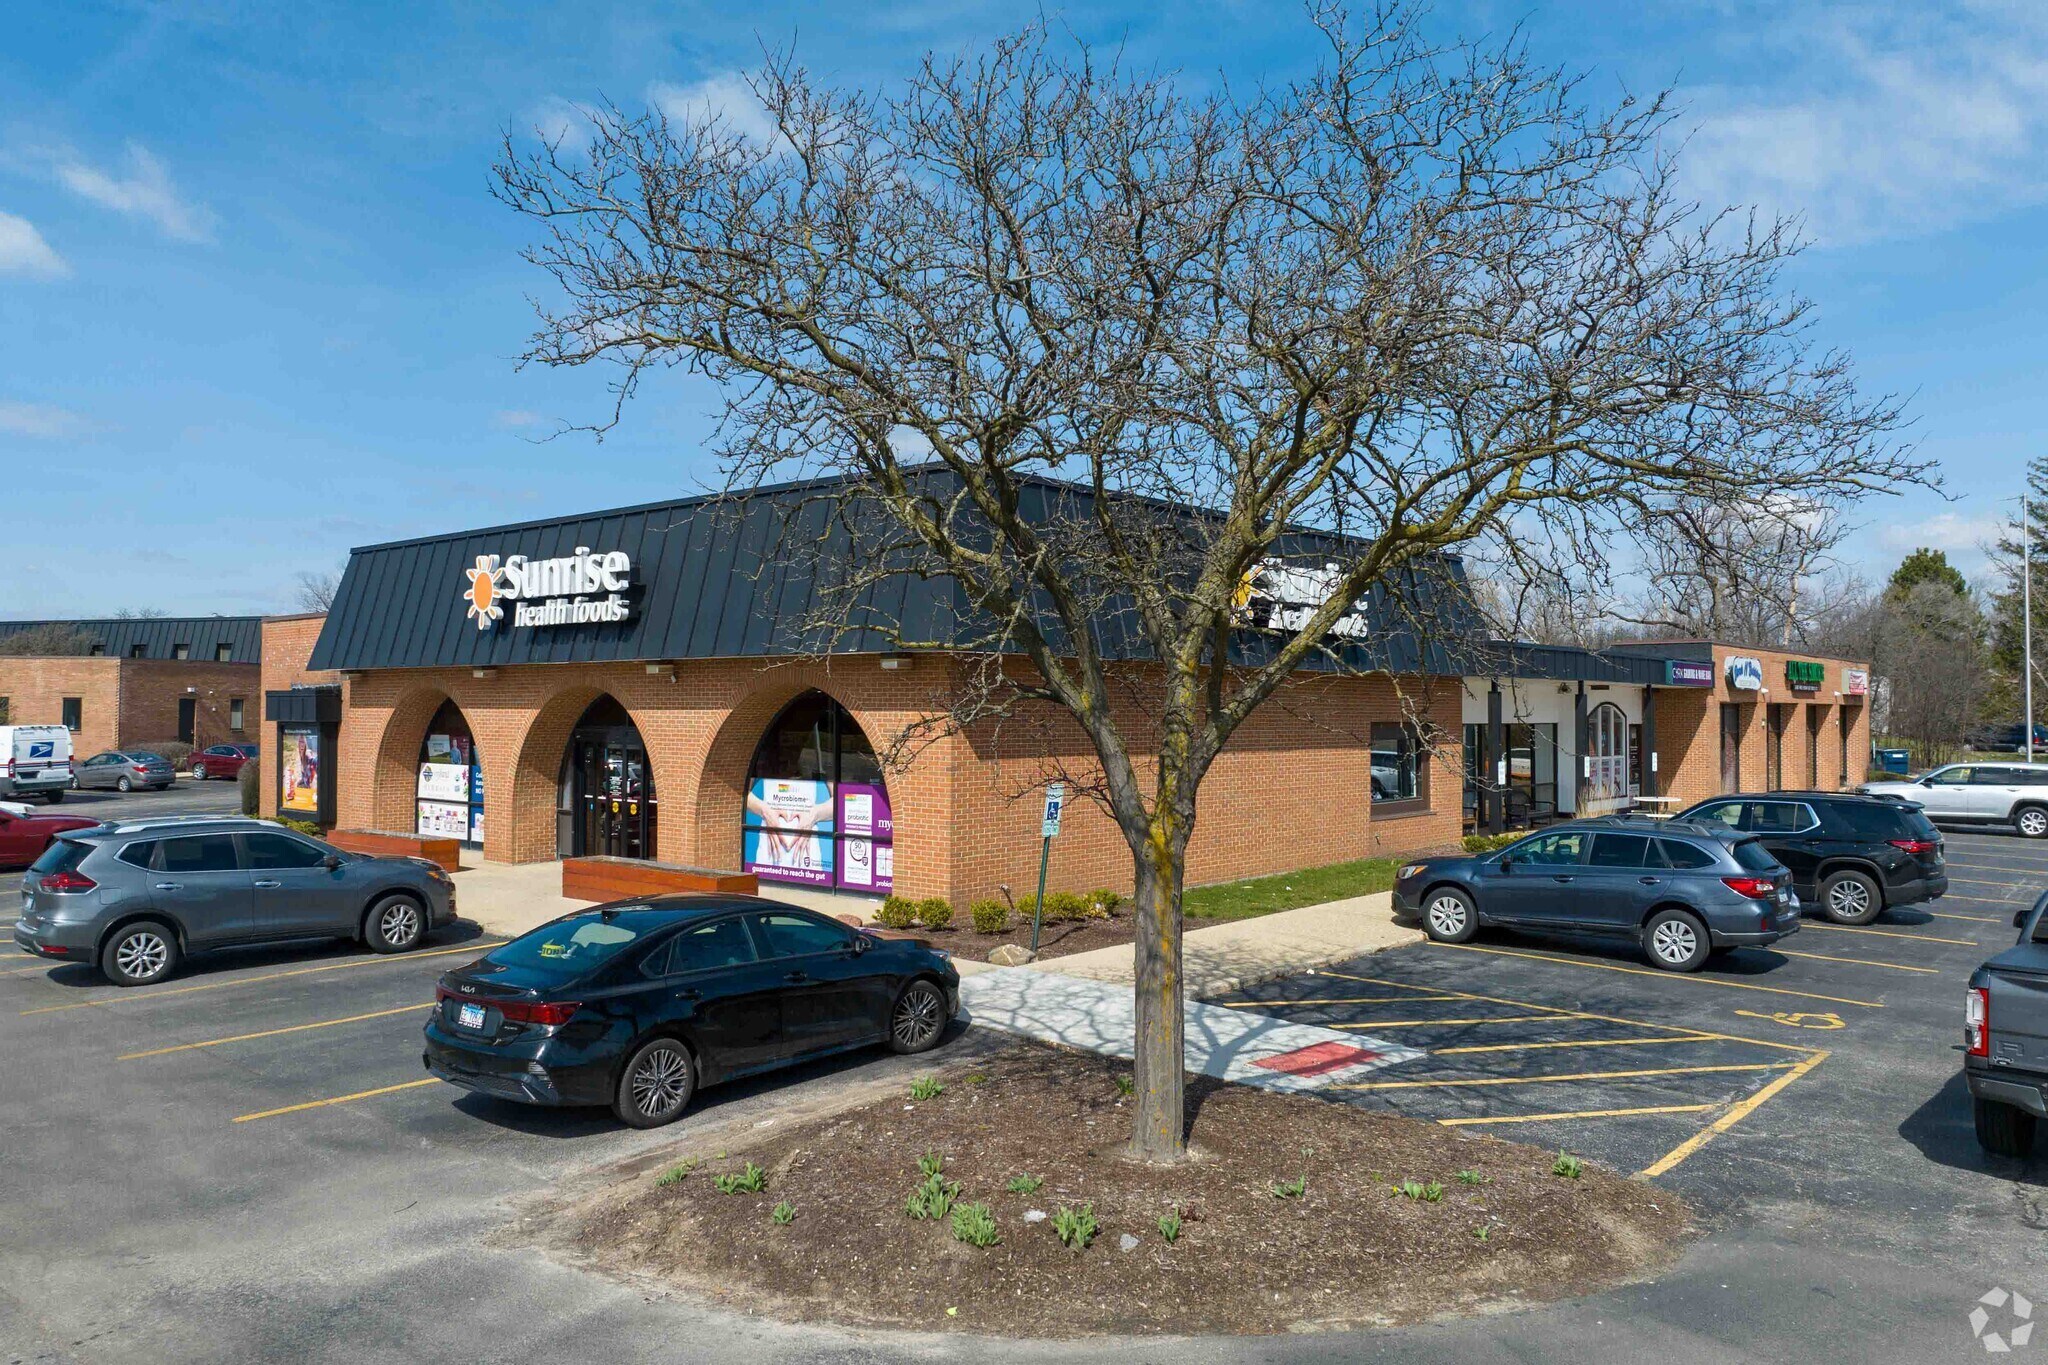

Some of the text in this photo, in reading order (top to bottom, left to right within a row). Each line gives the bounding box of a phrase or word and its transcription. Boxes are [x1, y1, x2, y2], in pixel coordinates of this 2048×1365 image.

[505, 546, 631, 599] Sunrise
[514, 594, 630, 628] health foods
[847, 814, 869, 822] probiotic
[878, 819, 893, 831] my
[752, 866, 782, 875] guaranteed
[789, 869, 805, 878] reach
[805, 870, 815, 879] the
[815, 873, 826, 881] gut
